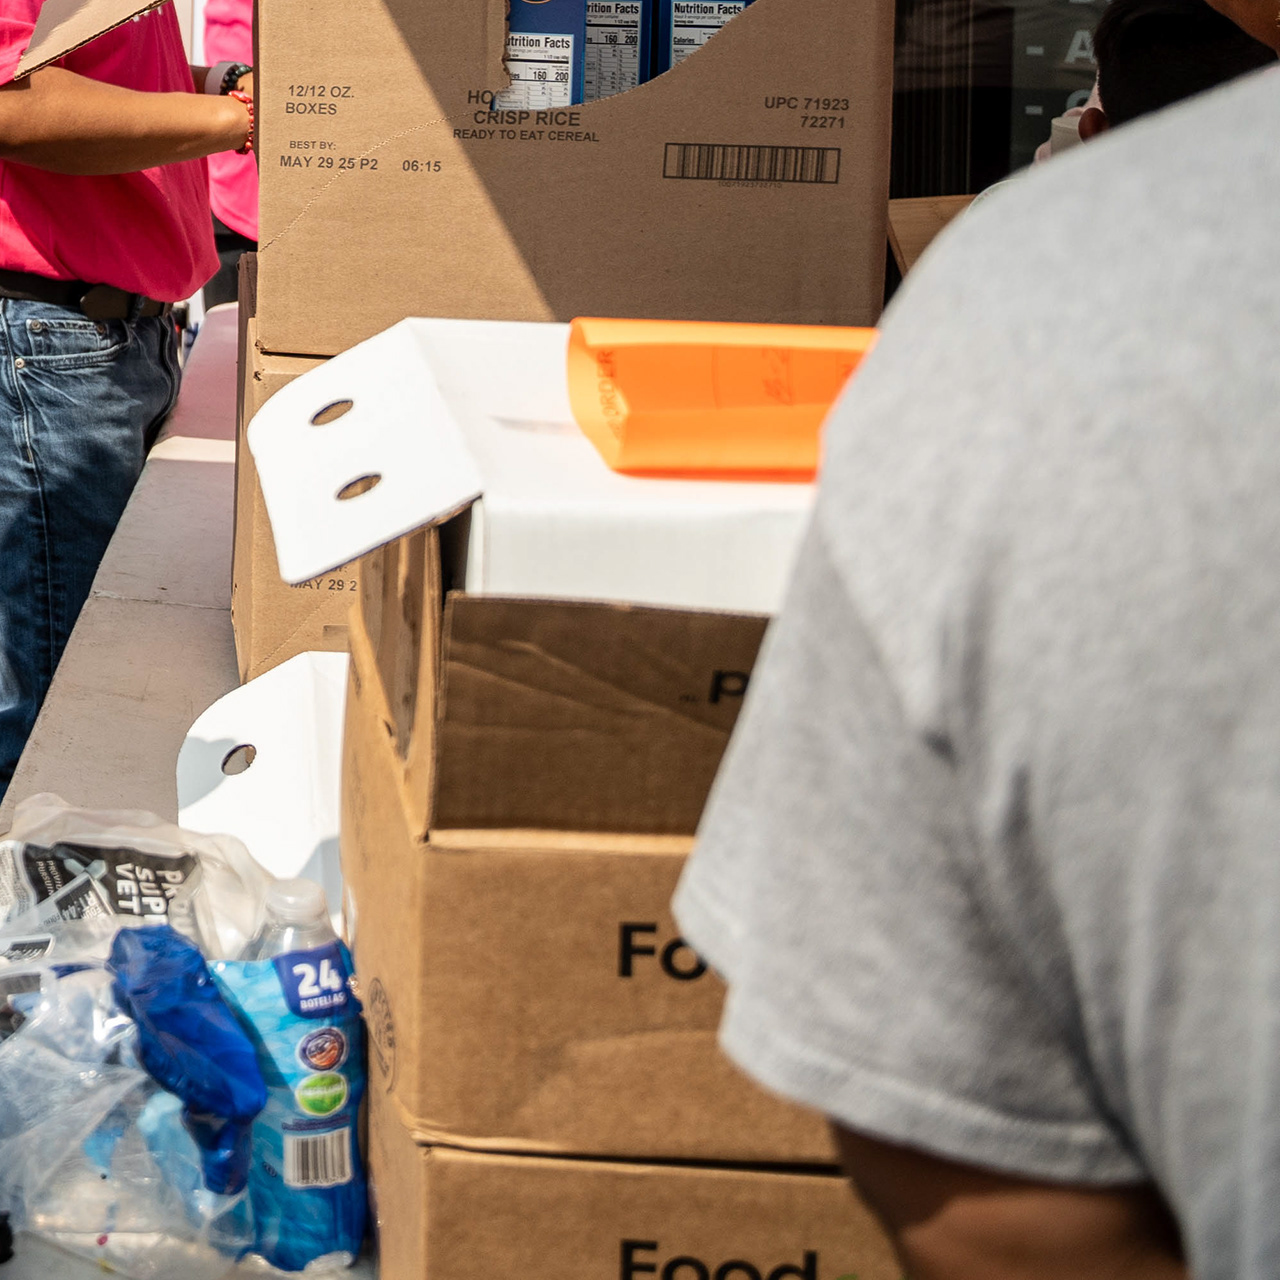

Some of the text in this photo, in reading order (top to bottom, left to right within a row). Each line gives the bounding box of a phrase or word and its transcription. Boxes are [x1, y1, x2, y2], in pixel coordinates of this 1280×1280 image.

[614, 4, 639, 15] Facts
[673, 3, 743, 16] Nutrition Facts
[544, 37, 571, 49] Facts
[604, 34, 638, 44] 160 200
[532, 70, 569, 81] 160 200
[288, 84, 355, 99] 12/12 OZ.
[285, 102, 337, 115] BOXES
[764, 96, 850, 111] UPC 71923
[474, 110, 581, 127] CRISP RICE
[800, 115, 845, 128] 72271
[453, 127, 600, 142] READY TO EAT CEREAL
[289, 140, 337, 151] BEST BY:
[280, 155, 442, 173] MAY 29 25 P2 06:15
[328, 579, 345, 591] 29
[115, 862, 140, 914] VET
[291, 958, 343, 998] 24
[299, 991, 347, 1010] BOTELLAS
